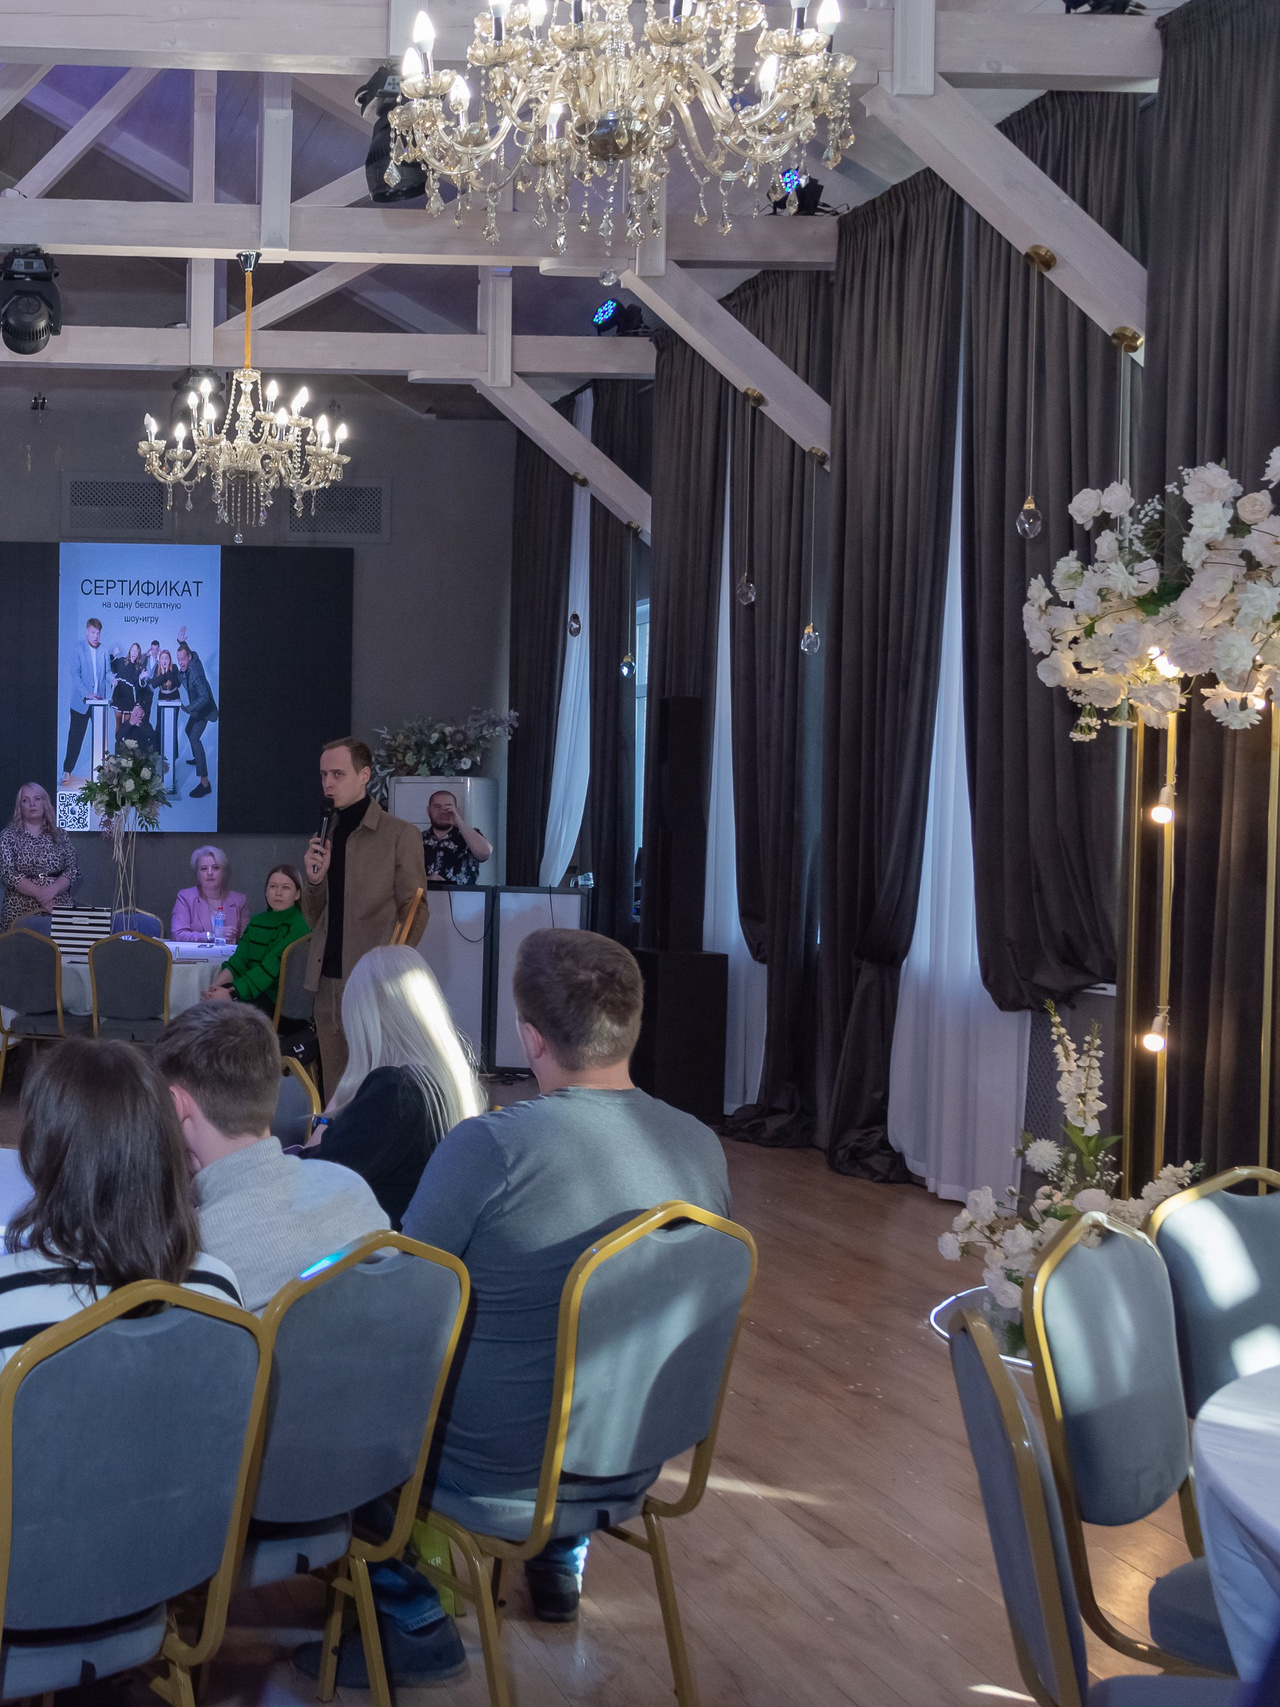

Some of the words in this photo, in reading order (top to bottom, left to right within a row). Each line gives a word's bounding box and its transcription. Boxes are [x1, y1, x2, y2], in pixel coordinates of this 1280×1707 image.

[80, 579, 203, 597] СЕРТИФИКАТ
[102, 601, 112, 609] на
[113, 601, 132, 611] одну
[134, 600, 182, 611] бесплатную
